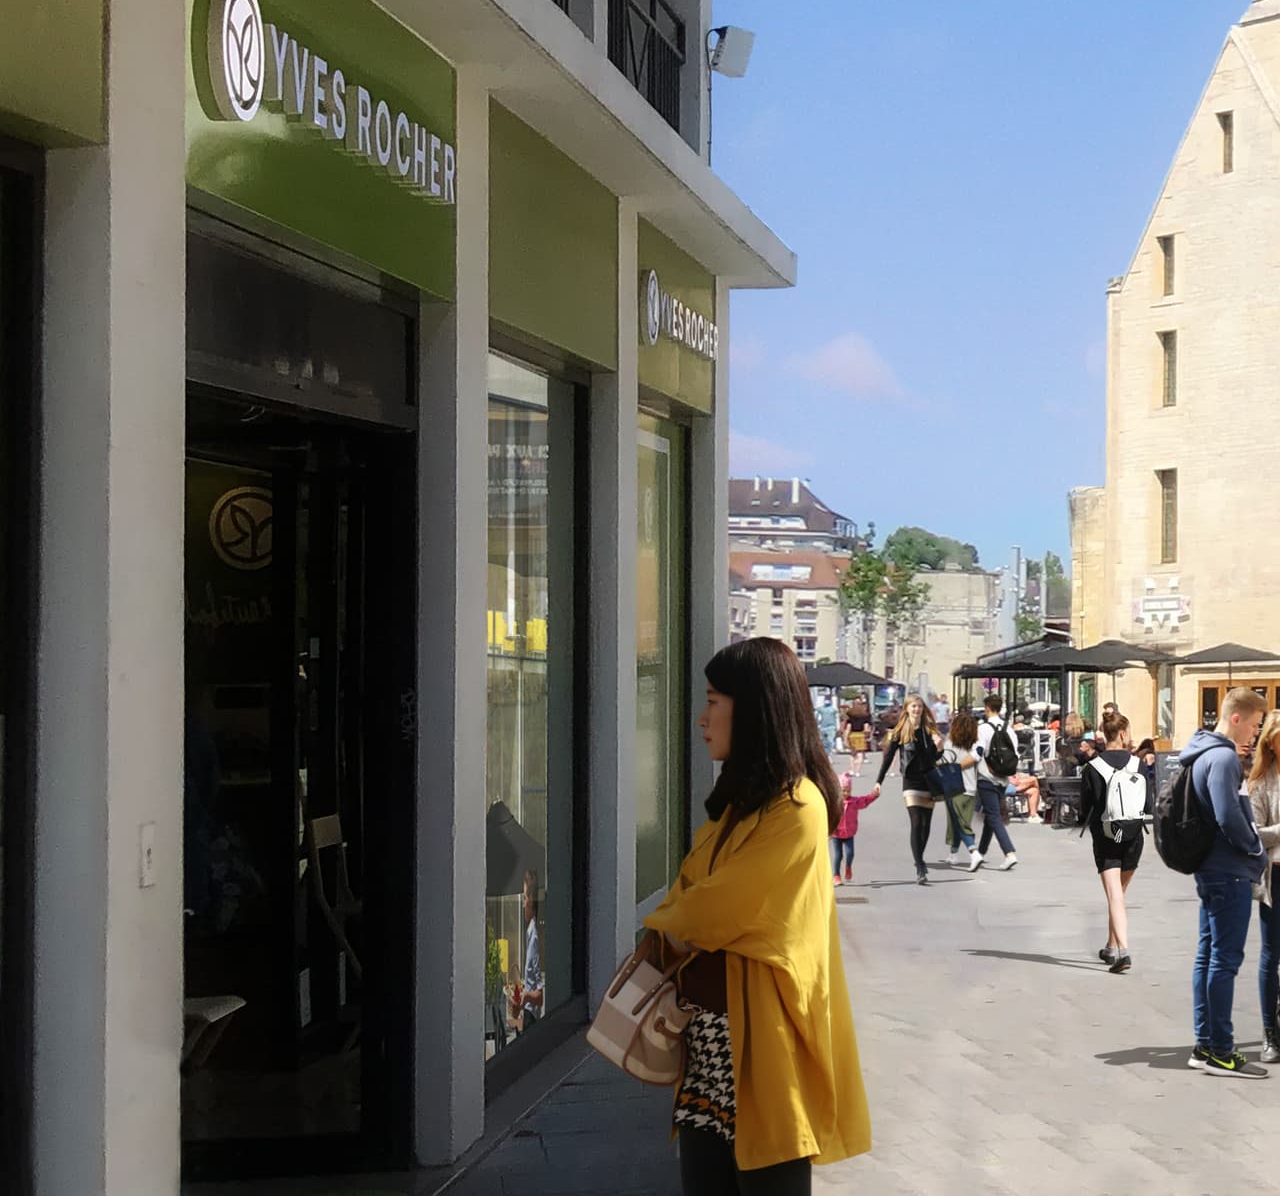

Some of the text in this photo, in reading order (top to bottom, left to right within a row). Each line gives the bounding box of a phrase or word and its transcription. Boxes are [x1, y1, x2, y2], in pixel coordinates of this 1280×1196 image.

[269, 22, 347, 140] YVES
[357, 84, 456, 205] ROCHER
[684, 307, 719, 361] ROCHER
